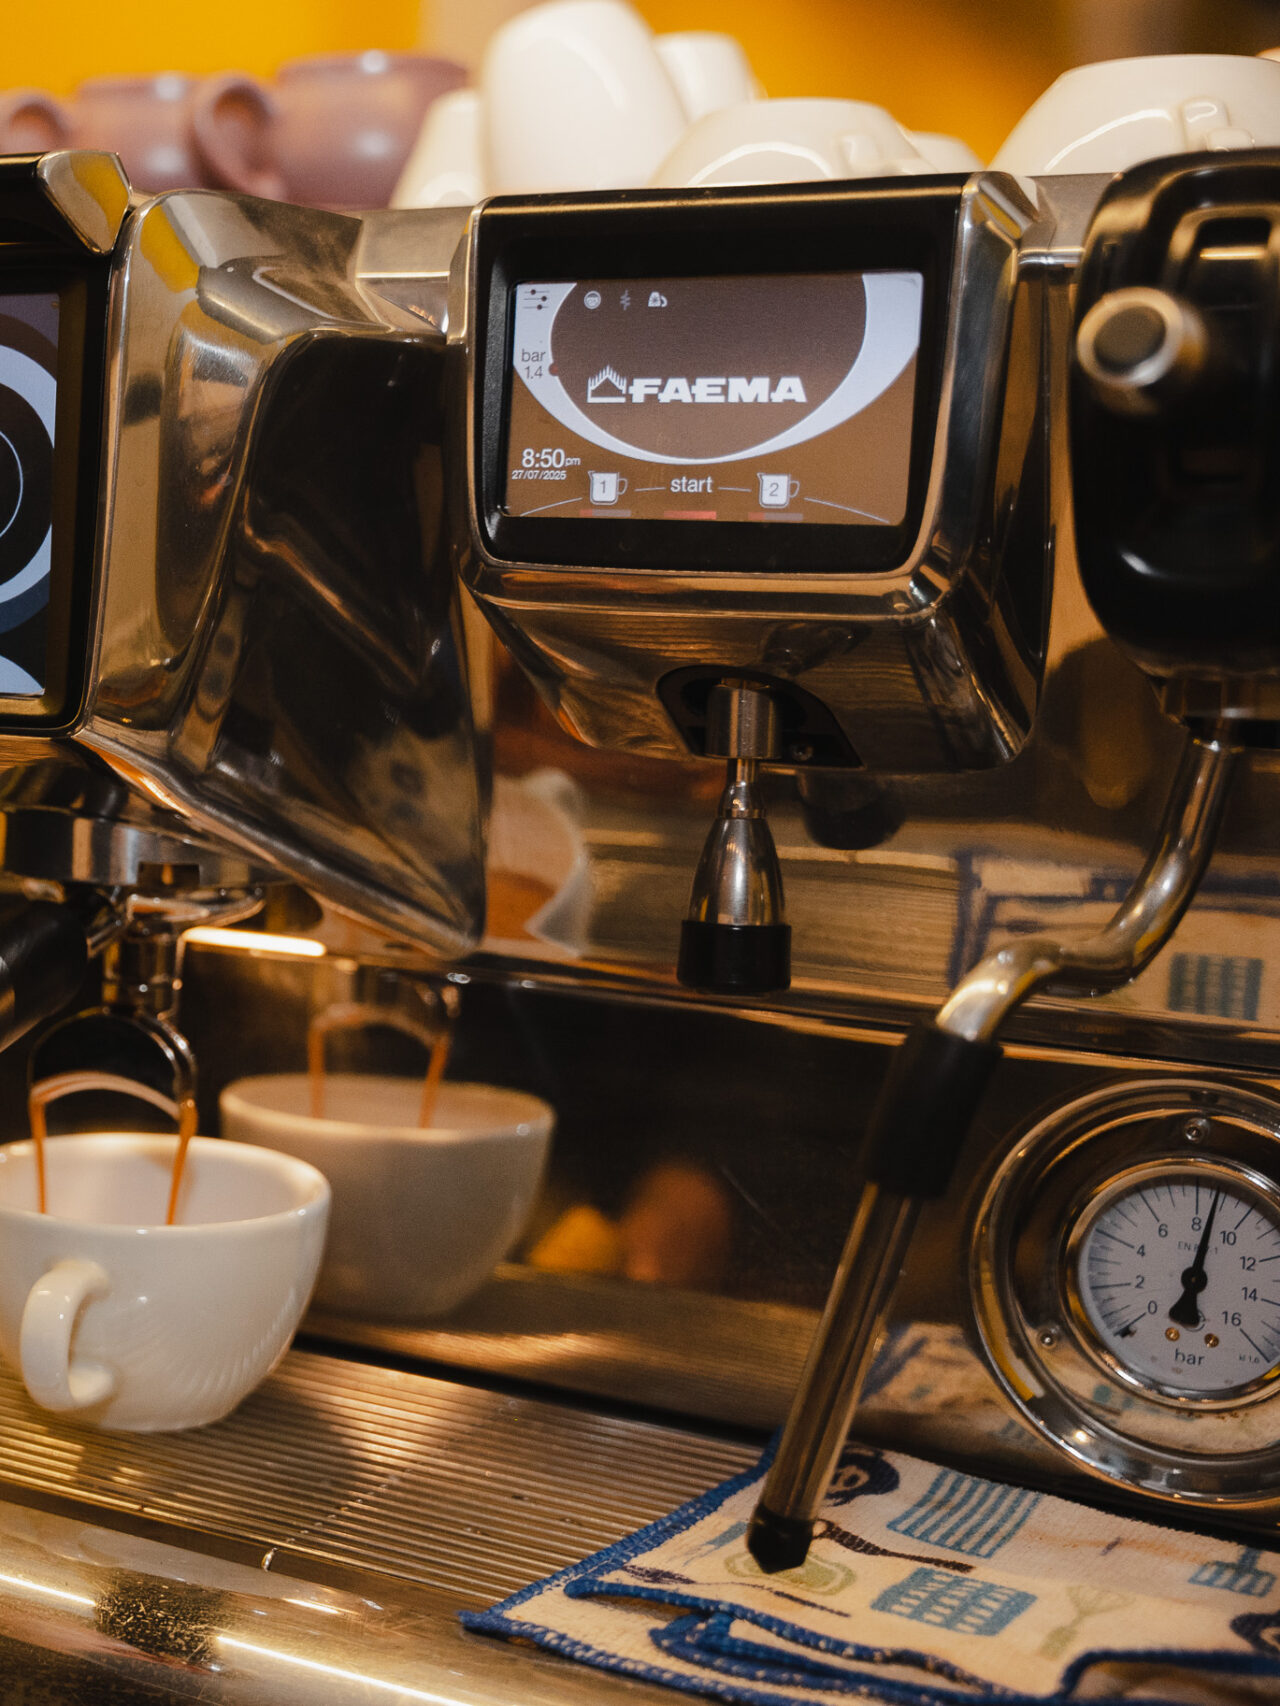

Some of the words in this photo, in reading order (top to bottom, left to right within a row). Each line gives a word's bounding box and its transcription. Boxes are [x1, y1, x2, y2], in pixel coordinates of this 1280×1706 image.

[521, 348, 546, 362] bar
[524, 365, 543, 379] 1.4
[629, 376, 807, 403] FAEMA
[600, 480, 606, 494] 1
[670, 476, 713, 493] start
[769, 482, 779, 497] 2
[1158, 1223, 1168, 1238] 6
[1191, 1216, 1202, 1232] 8
[1220, 1230, 1237, 1246] 10
[1136, 1244, 1146, 1257] 4
[1239, 1255, 1256, 1271] 12
[1134, 1274, 1145, 1289] 2
[1241, 1286, 1258, 1302] 14
[1147, 1300, 1158, 1315] 0
[1221, 1310, 1242, 1327] 16
[1174, 1348, 1205, 1366] bar
